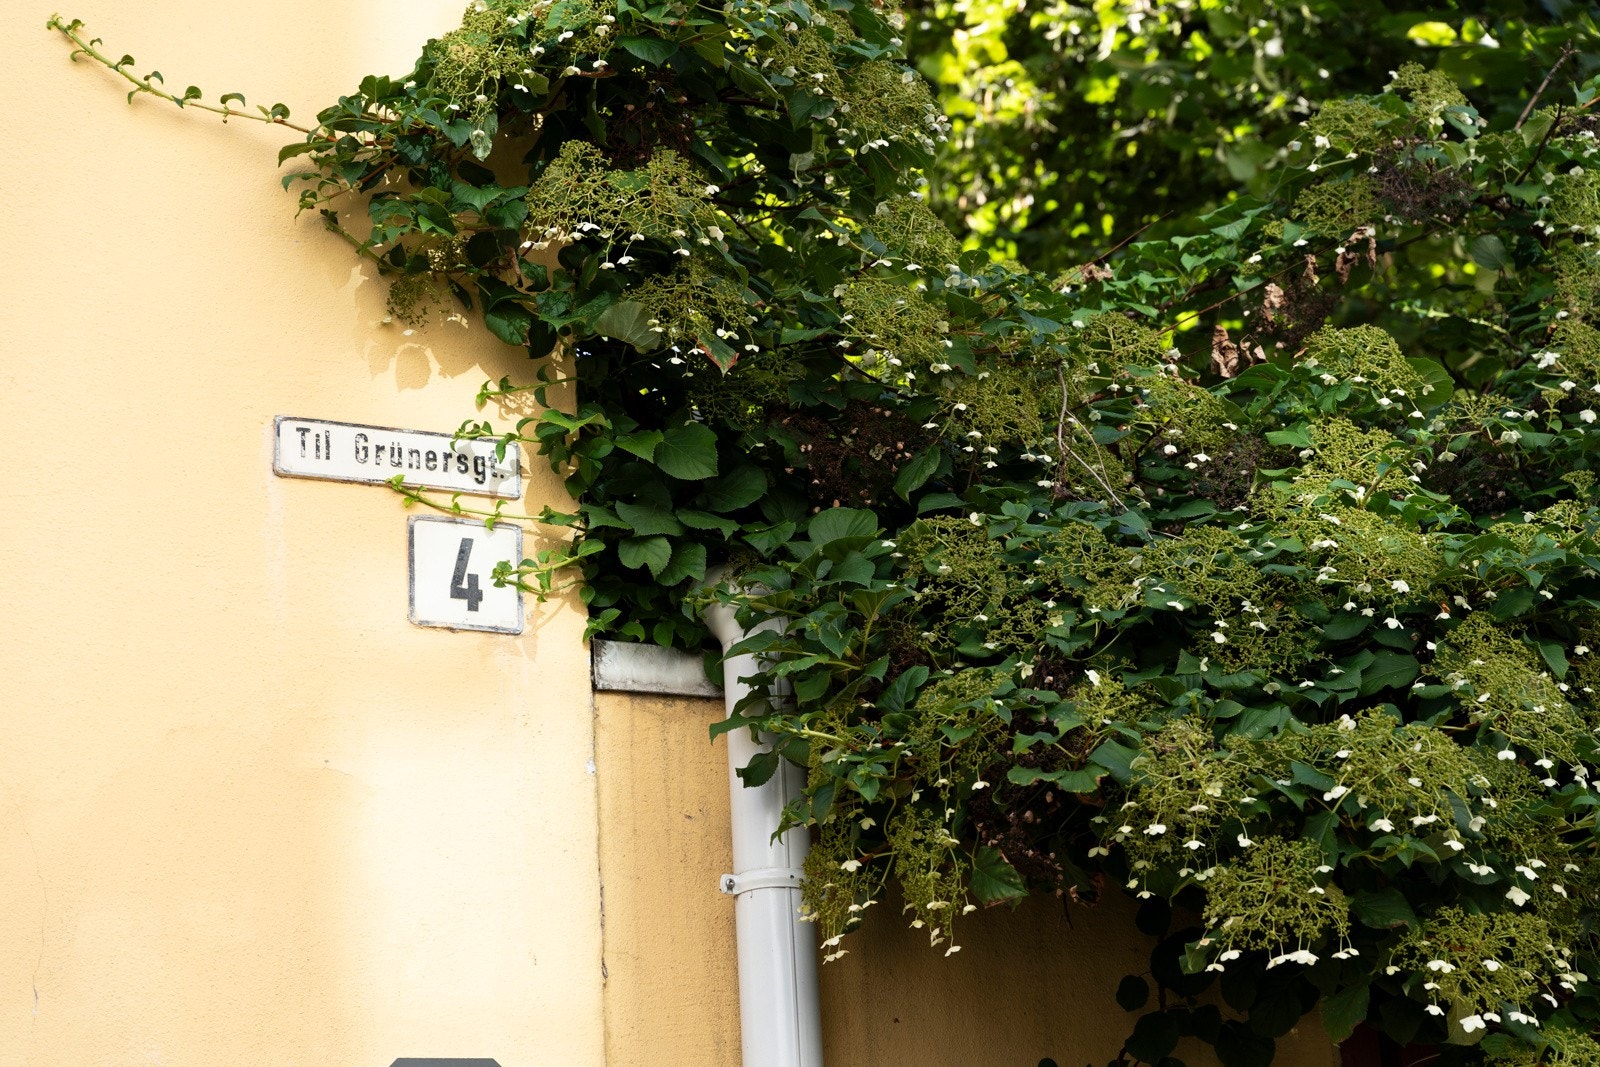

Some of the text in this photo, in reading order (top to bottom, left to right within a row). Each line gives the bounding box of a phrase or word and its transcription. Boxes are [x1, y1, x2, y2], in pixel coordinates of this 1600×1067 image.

[296, 427, 505, 485] Til Grünersgt.
[450, 537, 483, 612] 4
